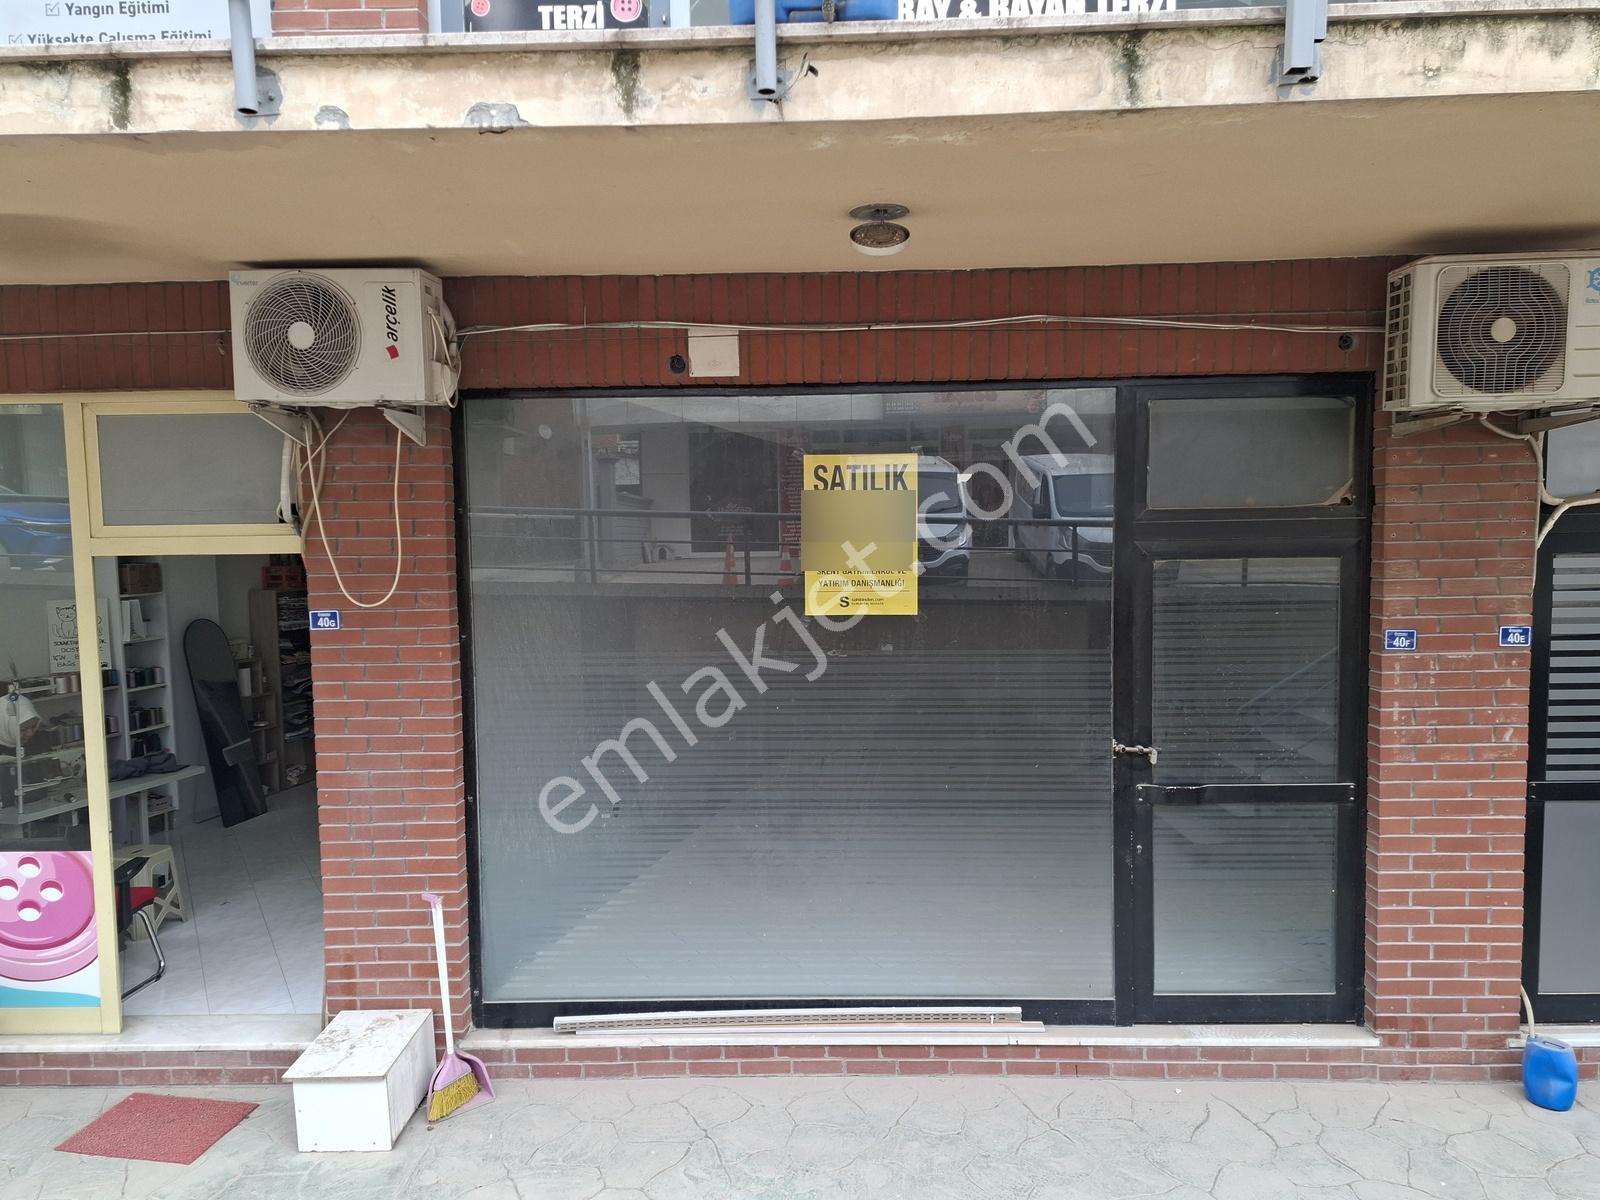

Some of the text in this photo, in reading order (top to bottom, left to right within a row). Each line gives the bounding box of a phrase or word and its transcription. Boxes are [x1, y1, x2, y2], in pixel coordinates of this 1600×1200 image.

[65, 1, 170, 18] Yangın Eğitimi
[381, 285, 401, 342] arçelik
[813, 463, 909, 491] SATILIK
[818, 579, 849, 588] YATIRIM
[317, 617, 336, 628] 40G
[1392, 636, 1411, 648] 40F
[1507, 632, 1526, 644] 40E
